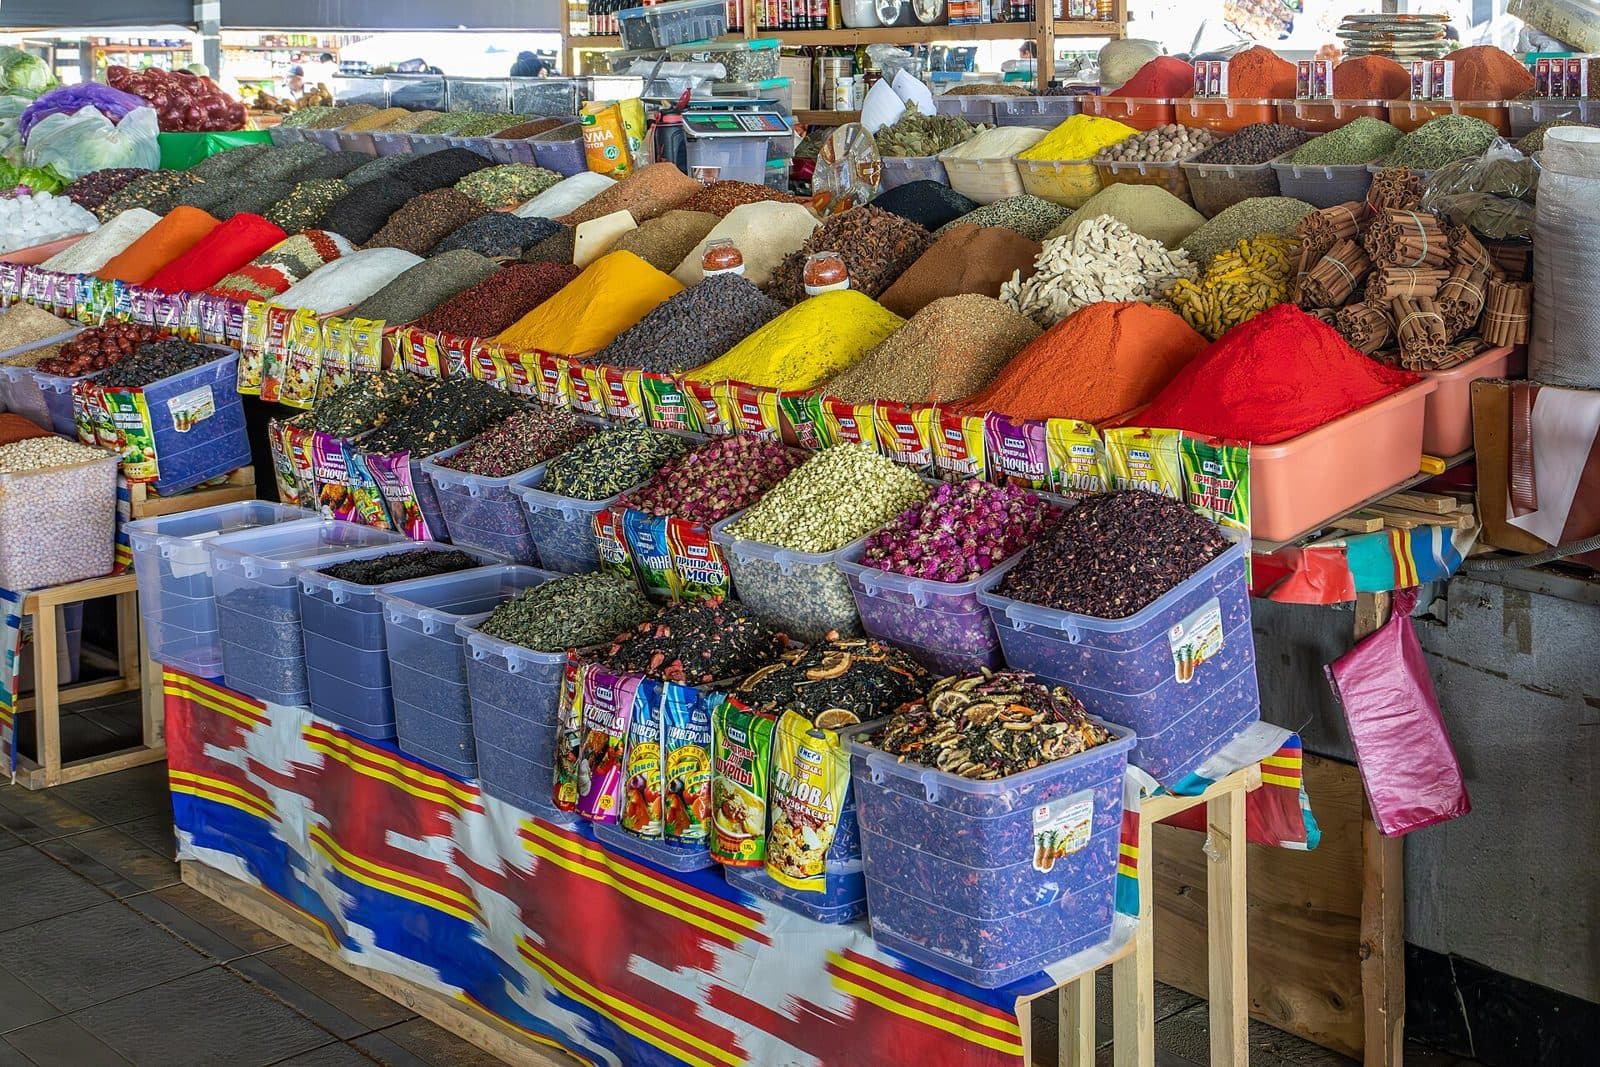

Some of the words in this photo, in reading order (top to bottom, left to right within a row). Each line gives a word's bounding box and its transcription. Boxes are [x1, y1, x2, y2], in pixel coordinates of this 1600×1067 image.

[686, 570, 725, 586] МЯСУ
[716, 757, 753, 787] ШУРПЫ
[776, 768, 833, 811] ПЛОВА
